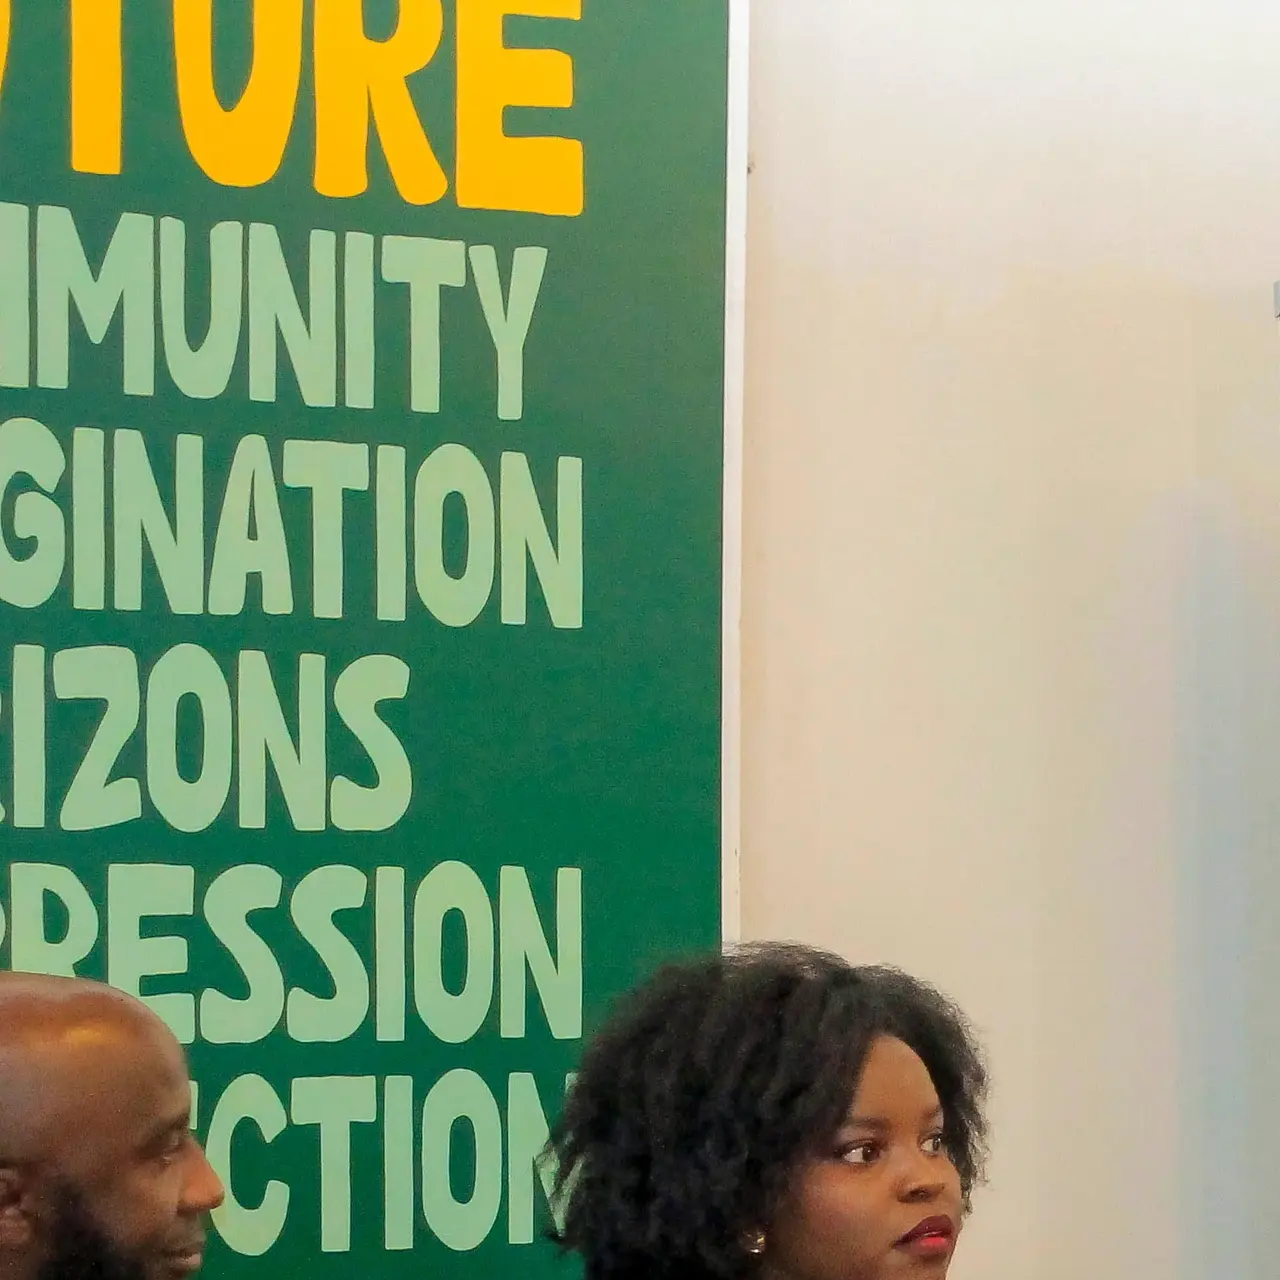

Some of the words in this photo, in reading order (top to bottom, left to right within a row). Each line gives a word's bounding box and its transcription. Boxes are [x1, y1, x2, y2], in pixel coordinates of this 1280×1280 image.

[0, 0, 583, 217] TURE
[0, 203, 548, 421] MUNITY
[0, 417, 583, 629] GINATION
[0, 643, 413, 832] IZONS
[0, 860, 583, 1043] RESSION
[189, 1067, 587, 1256] CTION
